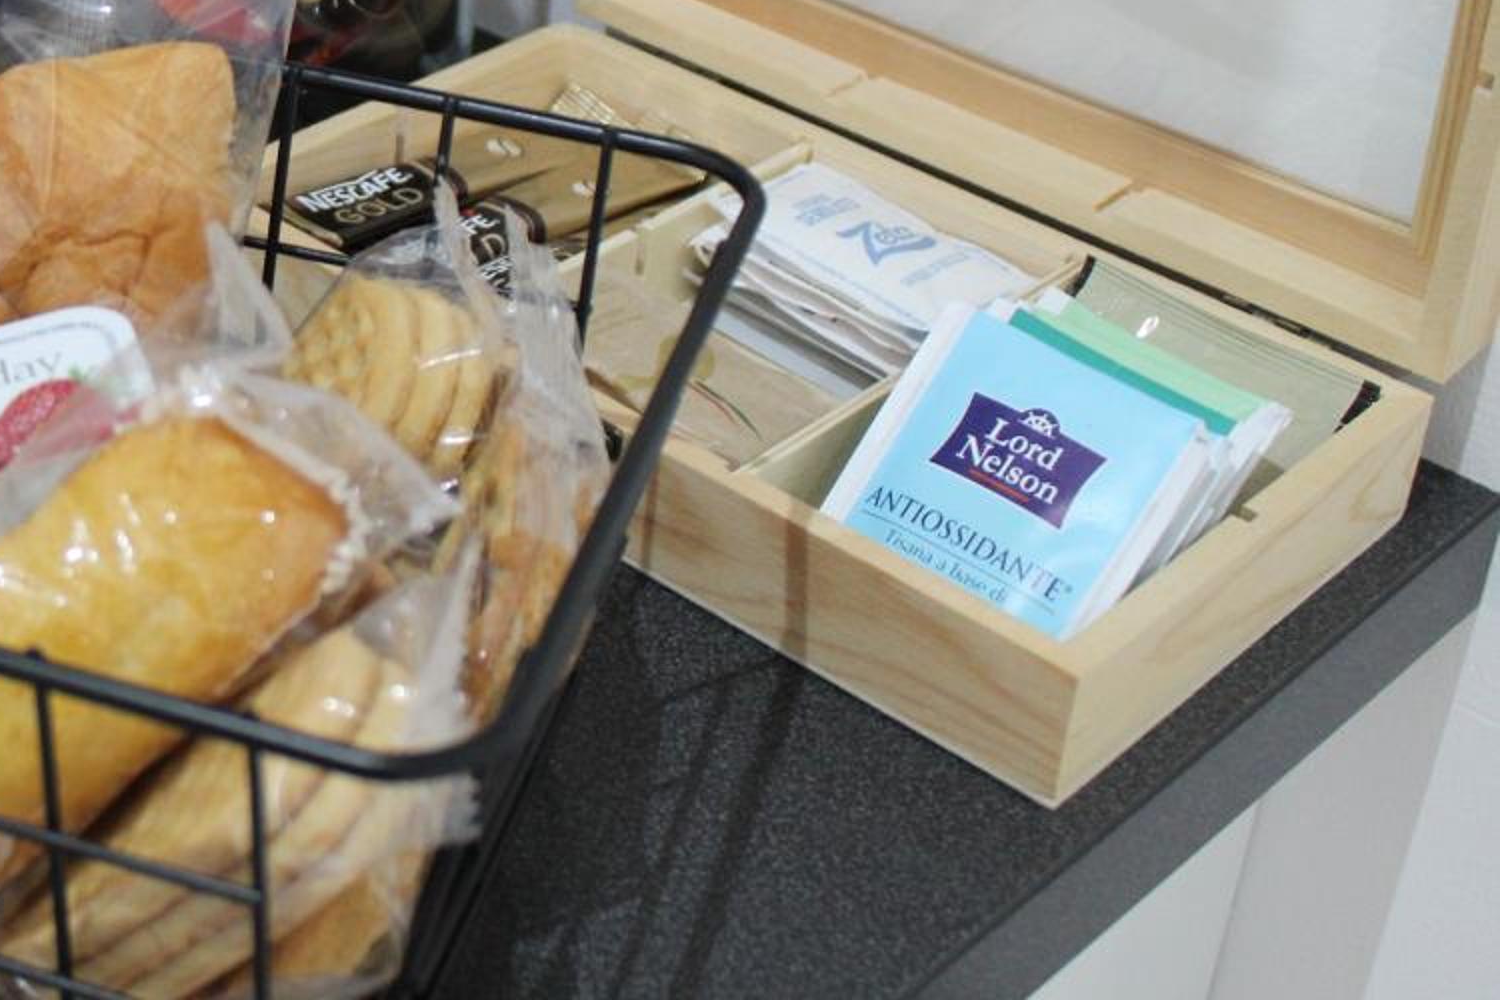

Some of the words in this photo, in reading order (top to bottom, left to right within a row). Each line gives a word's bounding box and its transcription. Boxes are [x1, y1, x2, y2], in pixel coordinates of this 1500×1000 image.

[334, 187, 424, 224] GOLD
[955, 433, 1060, 505] Nelson
[984, 416, 1064, 472] Lord
